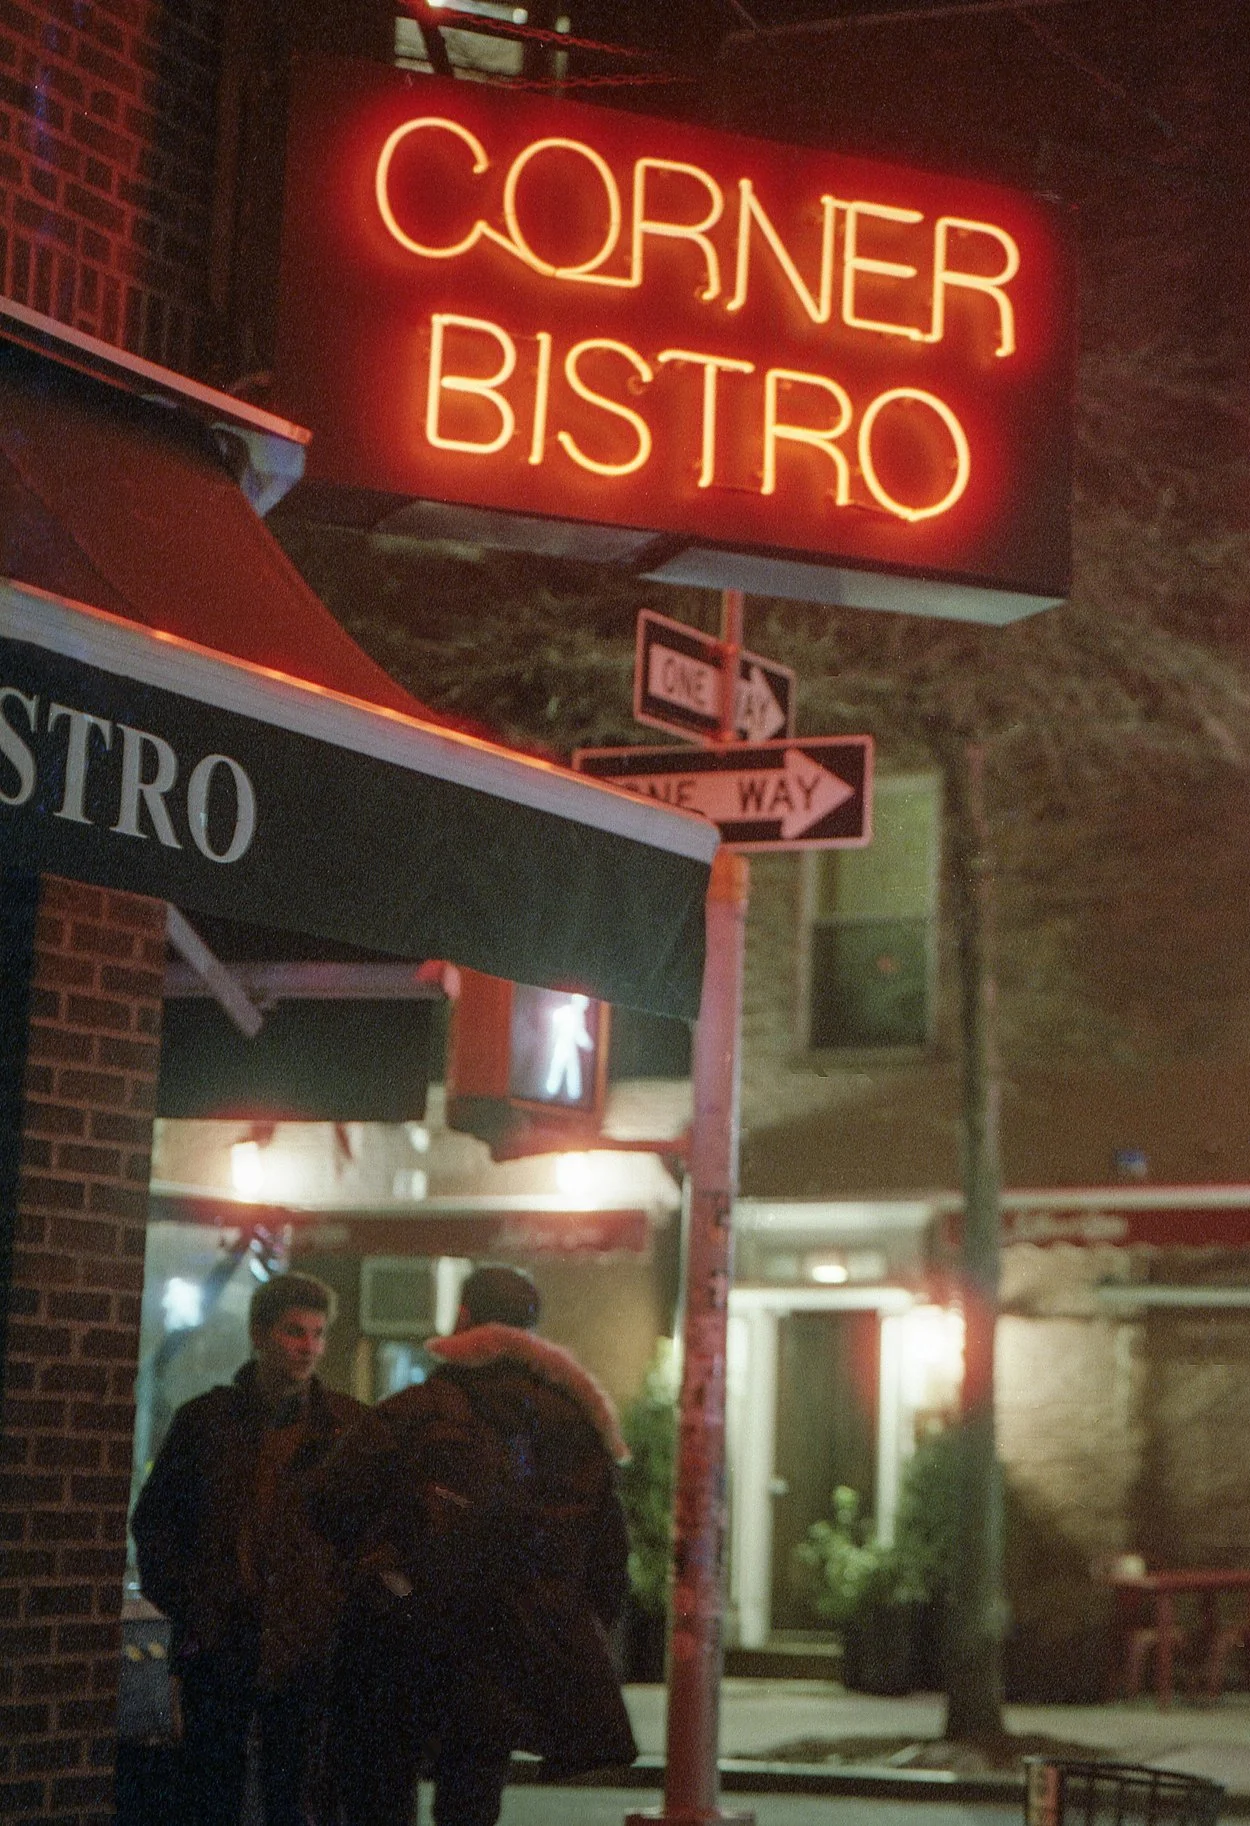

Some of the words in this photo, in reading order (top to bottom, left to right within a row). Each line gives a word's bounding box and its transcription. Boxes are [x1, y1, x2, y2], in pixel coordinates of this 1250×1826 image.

[375, 116, 1020, 357] CORNER
[425, 312, 971, 522] BISTRO
[661, 656, 706, 706] ONE
[737, 774, 820, 812] WAY
